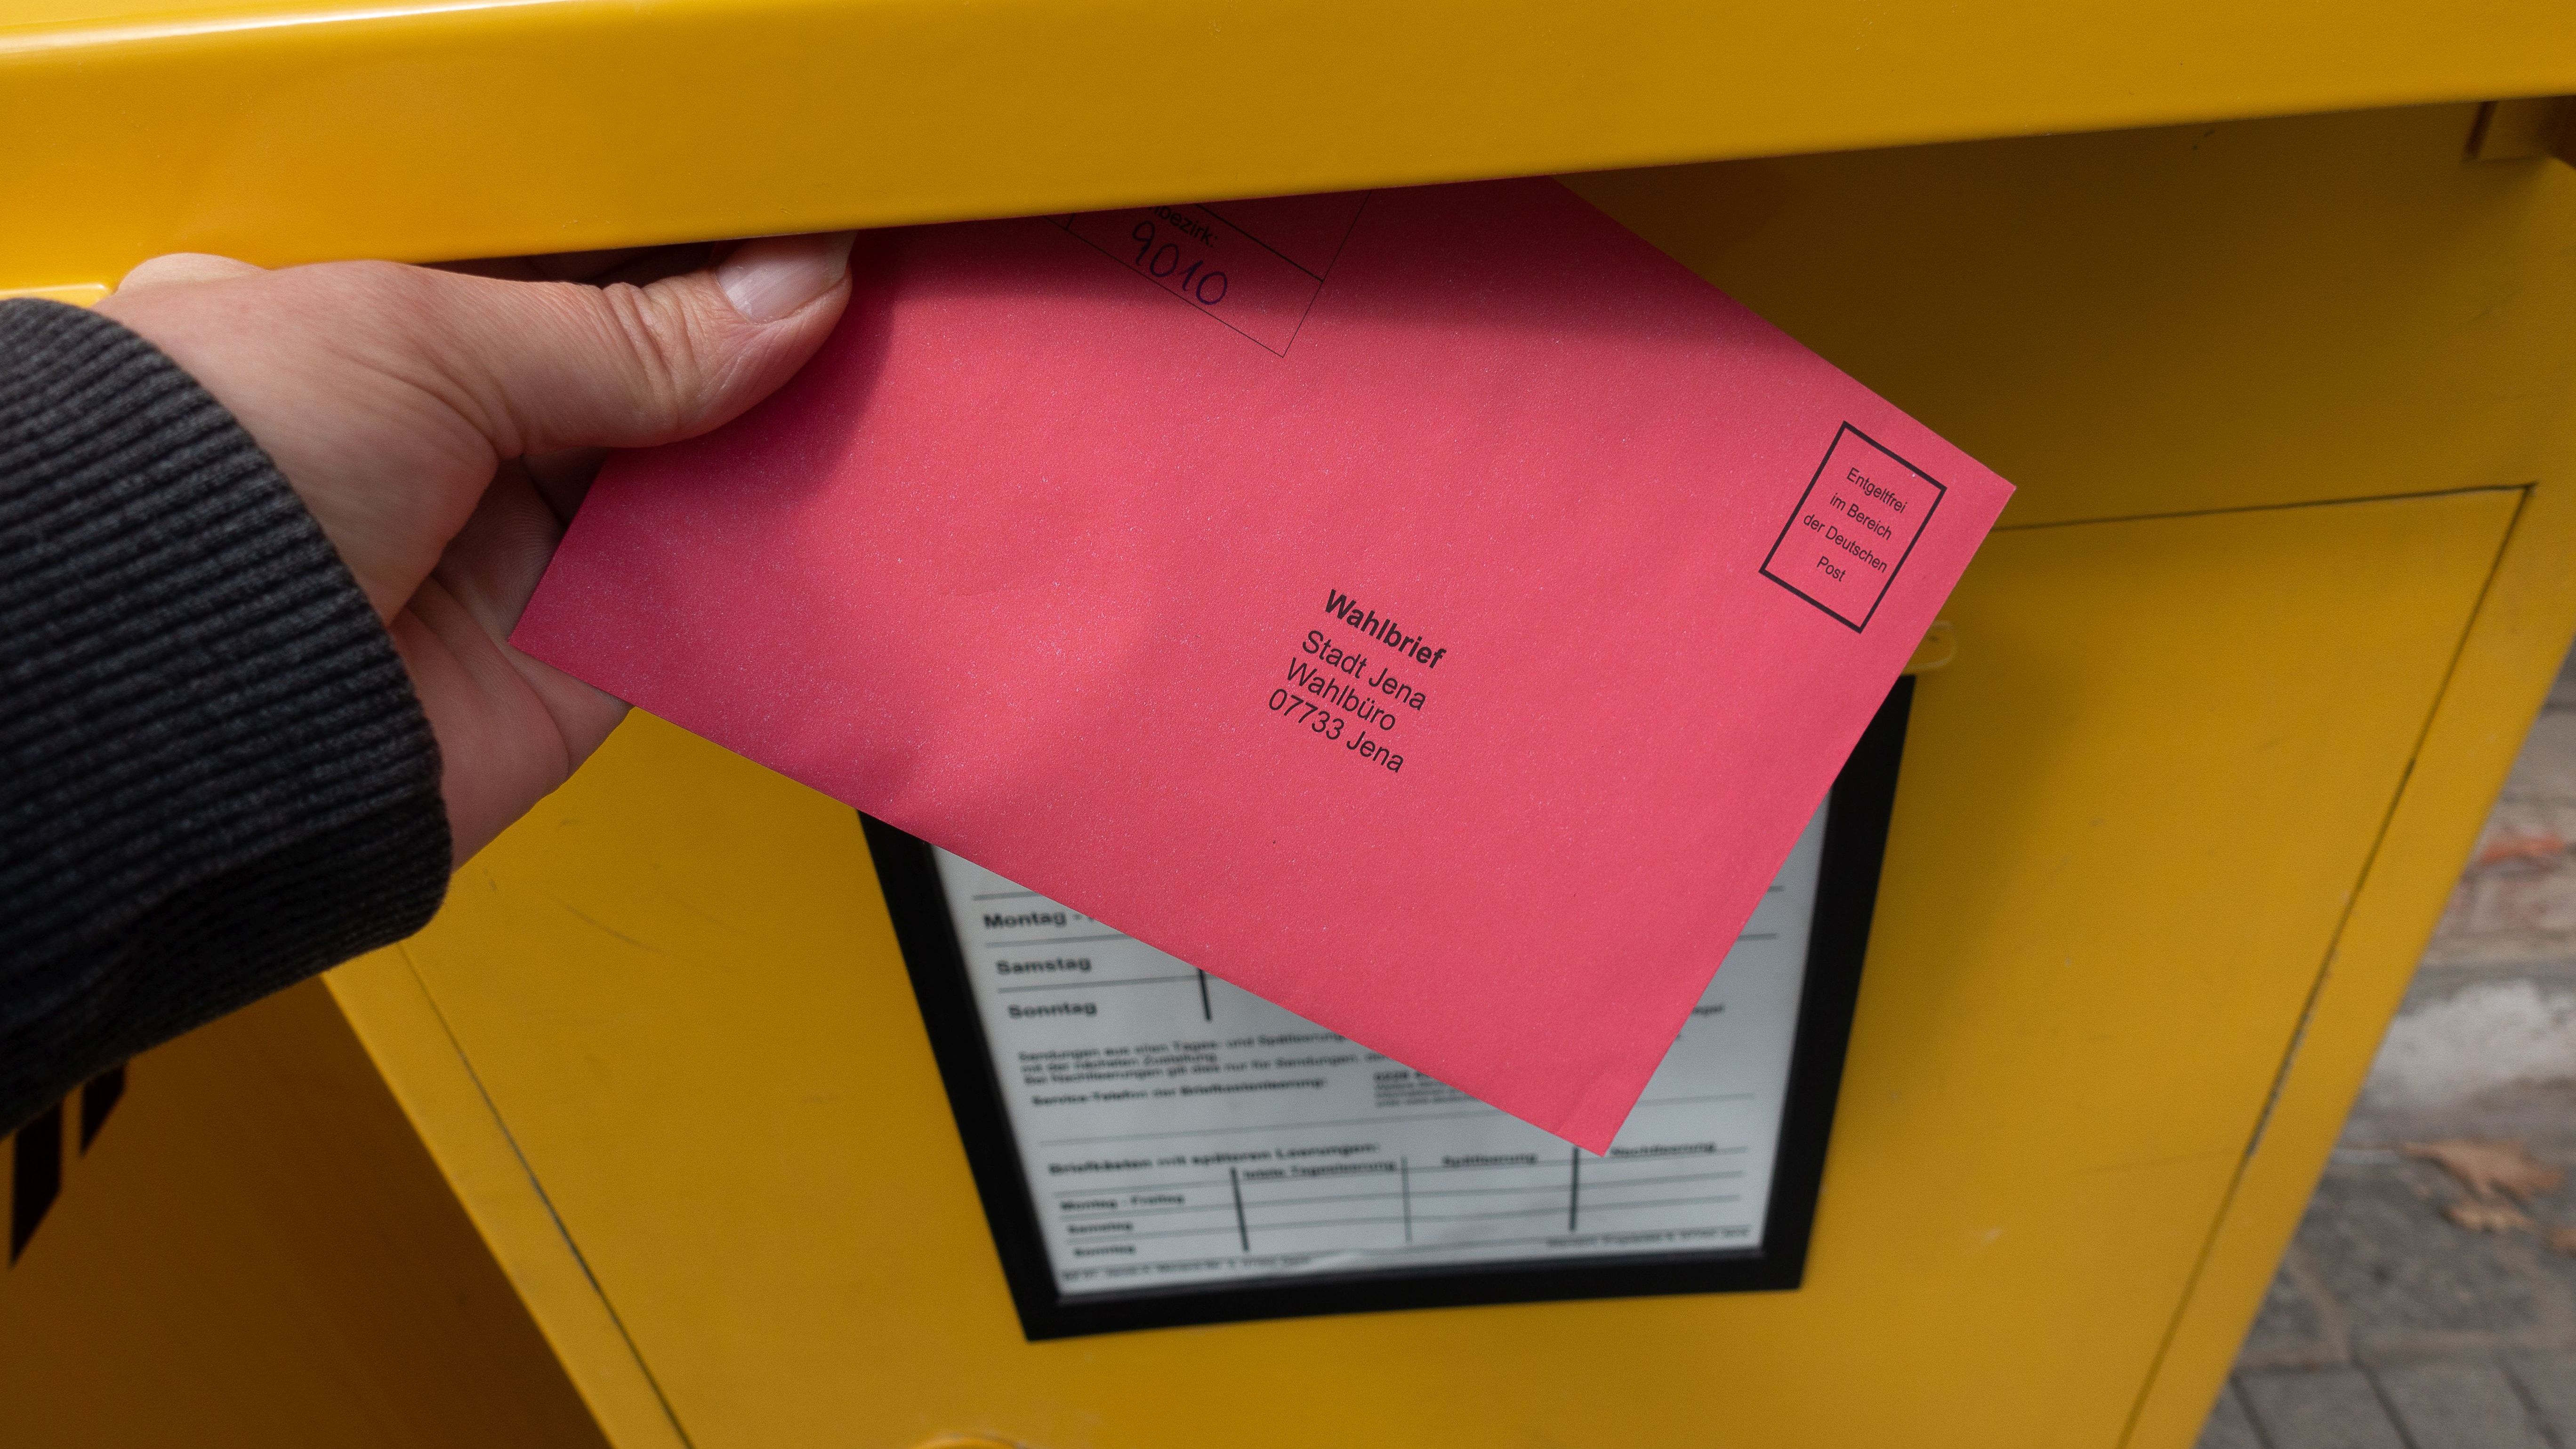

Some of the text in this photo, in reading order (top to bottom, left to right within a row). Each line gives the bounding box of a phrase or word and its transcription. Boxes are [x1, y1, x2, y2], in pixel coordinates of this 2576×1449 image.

[1149, 206, 1218, 248] bezirk:
[1132, 220, 1228, 306] 9010
[1846, 467, 1907, 513] Entgeltfrei
[1829, 492, 1892, 540] im Bereich
[1803, 514, 1888, 573] der Deutschen
[1816, 555, 1846, 582] Post
[1325, 588, 1447, 669] Wahlbrief
[1287, 657, 1396, 731] Wahlbüro
[1302, 629, 1426, 711] Stadt Jena
[1268, 688, 1404, 773] 07733 Jena
[983, 911, 1067, 929] Montag
[996, 957, 1092, 975] Samstag
[1007, 1002, 1098, 1019] Sonntag
